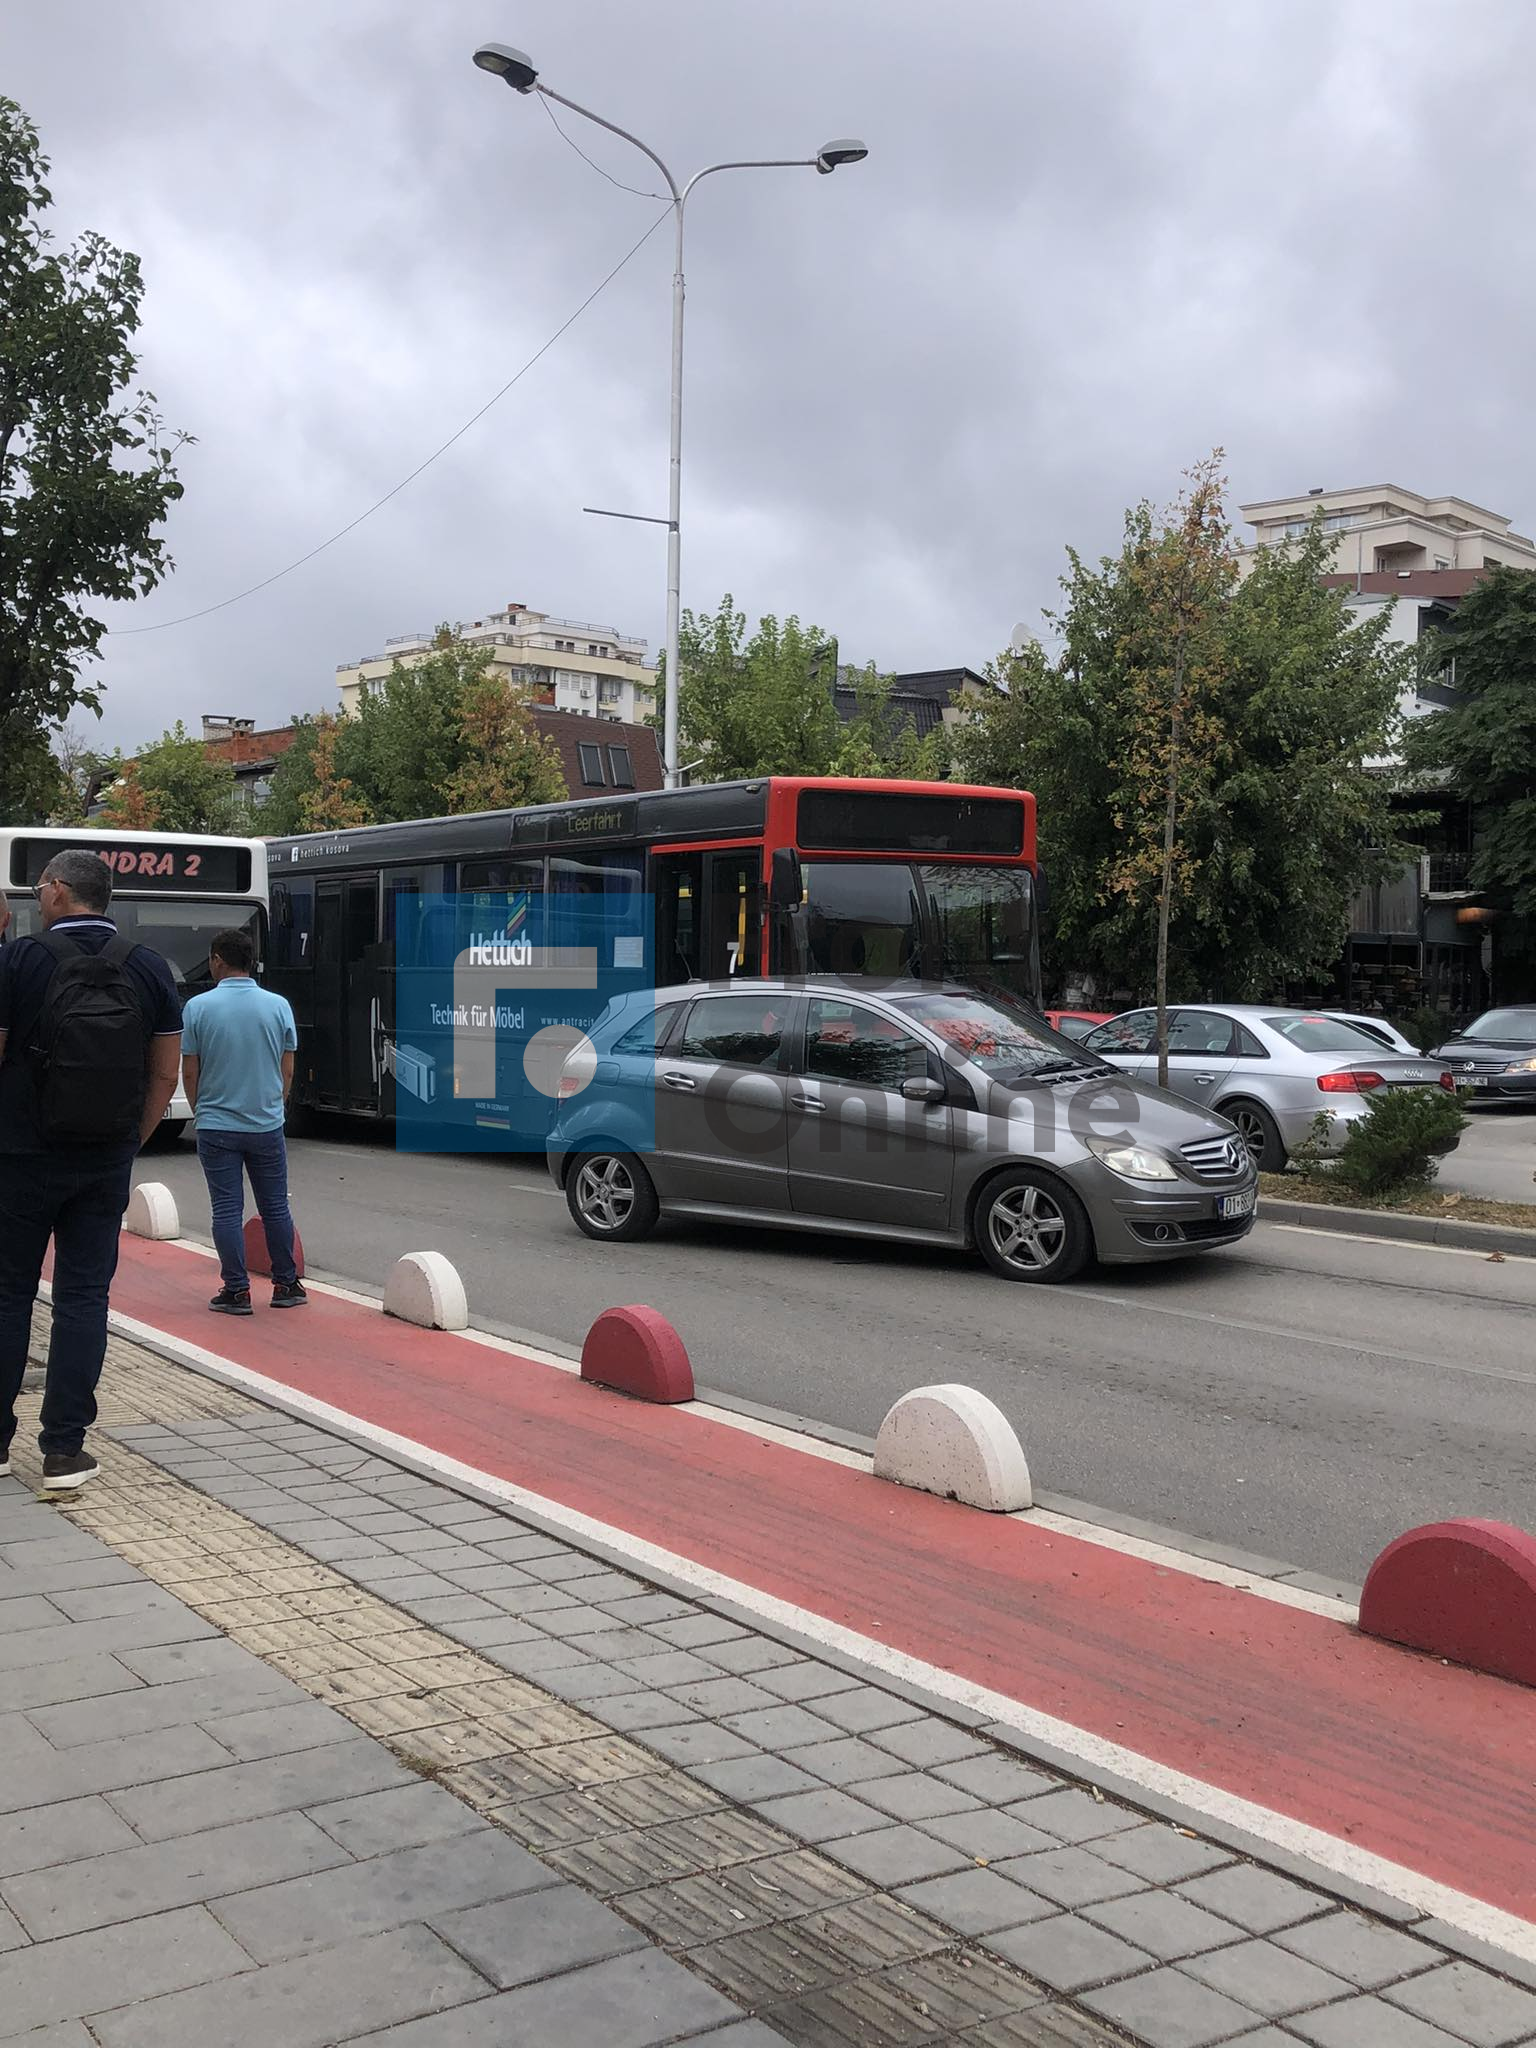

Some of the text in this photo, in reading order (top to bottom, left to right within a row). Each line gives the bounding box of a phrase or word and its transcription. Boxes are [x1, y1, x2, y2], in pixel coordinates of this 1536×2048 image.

[568, 810, 622, 833] Leerfahrt
[183, 854, 202, 877] 2
[300, 932, 308, 956] 7
[469, 929, 532, 966] Hettich
[727, 942, 740, 974] 7
[430, 1003, 525, 1029] Technik für Möbel
